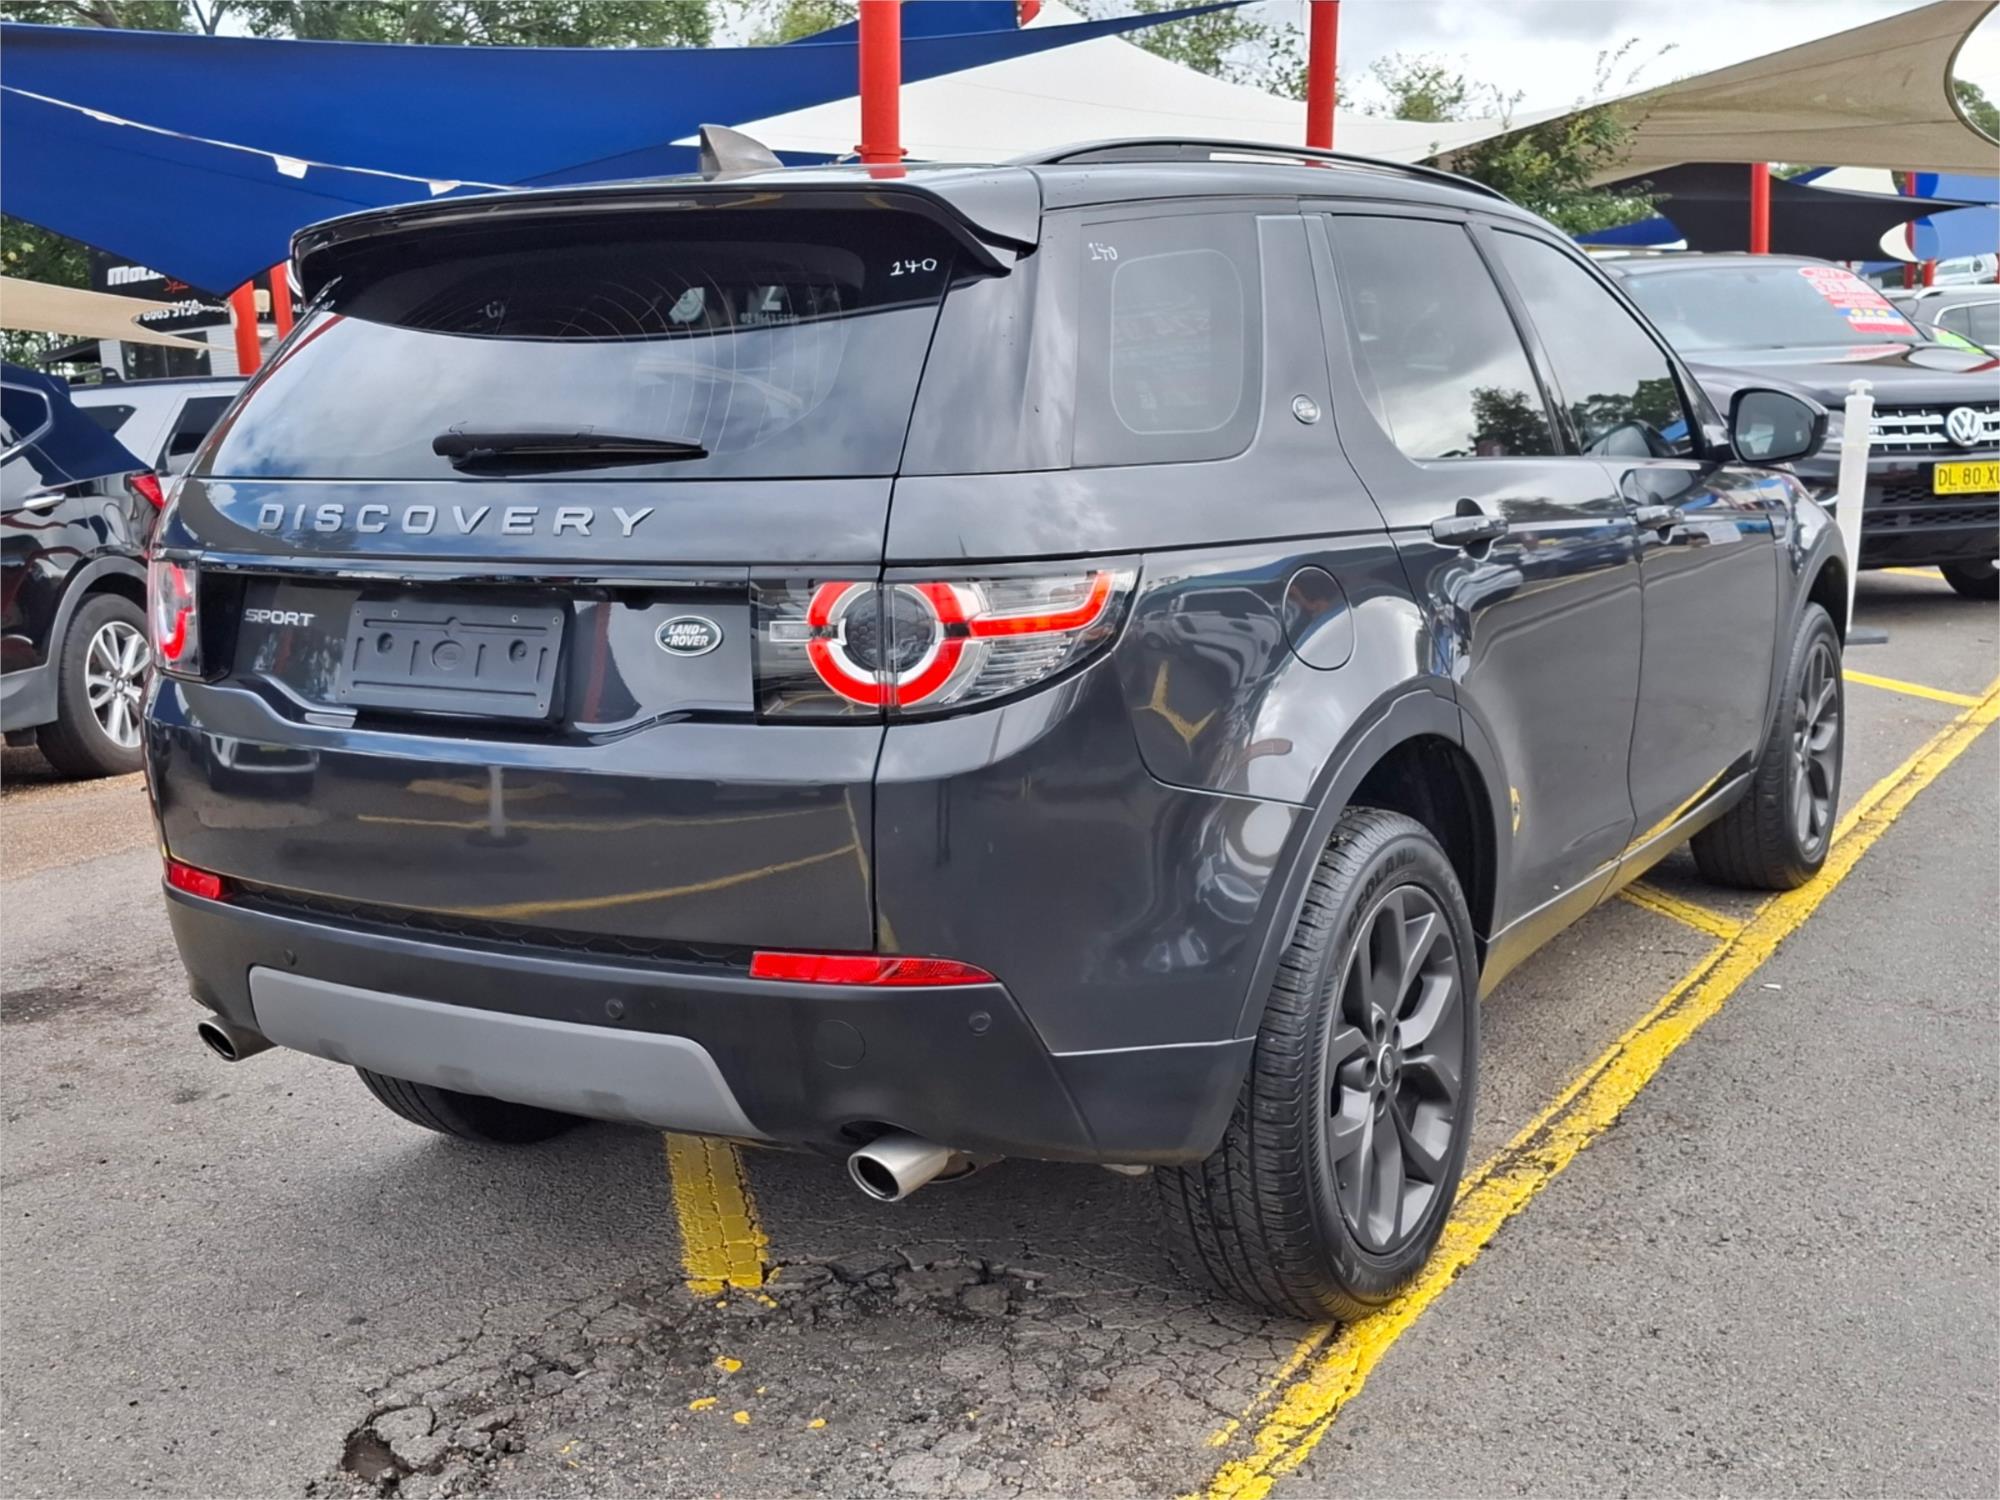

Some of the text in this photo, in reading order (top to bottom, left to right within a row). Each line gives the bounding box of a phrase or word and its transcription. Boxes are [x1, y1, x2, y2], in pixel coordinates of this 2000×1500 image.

[890, 257, 938, 276] 140
[1938, 468, 1957, 487] DL
[1963, 466, 1981, 485] 80
[256, 503, 655, 537] DISCOVERY
[244, 608, 316, 627] SPORT
[668, 624, 700, 635] LAND
[669, 635, 709, 646] ROVER
